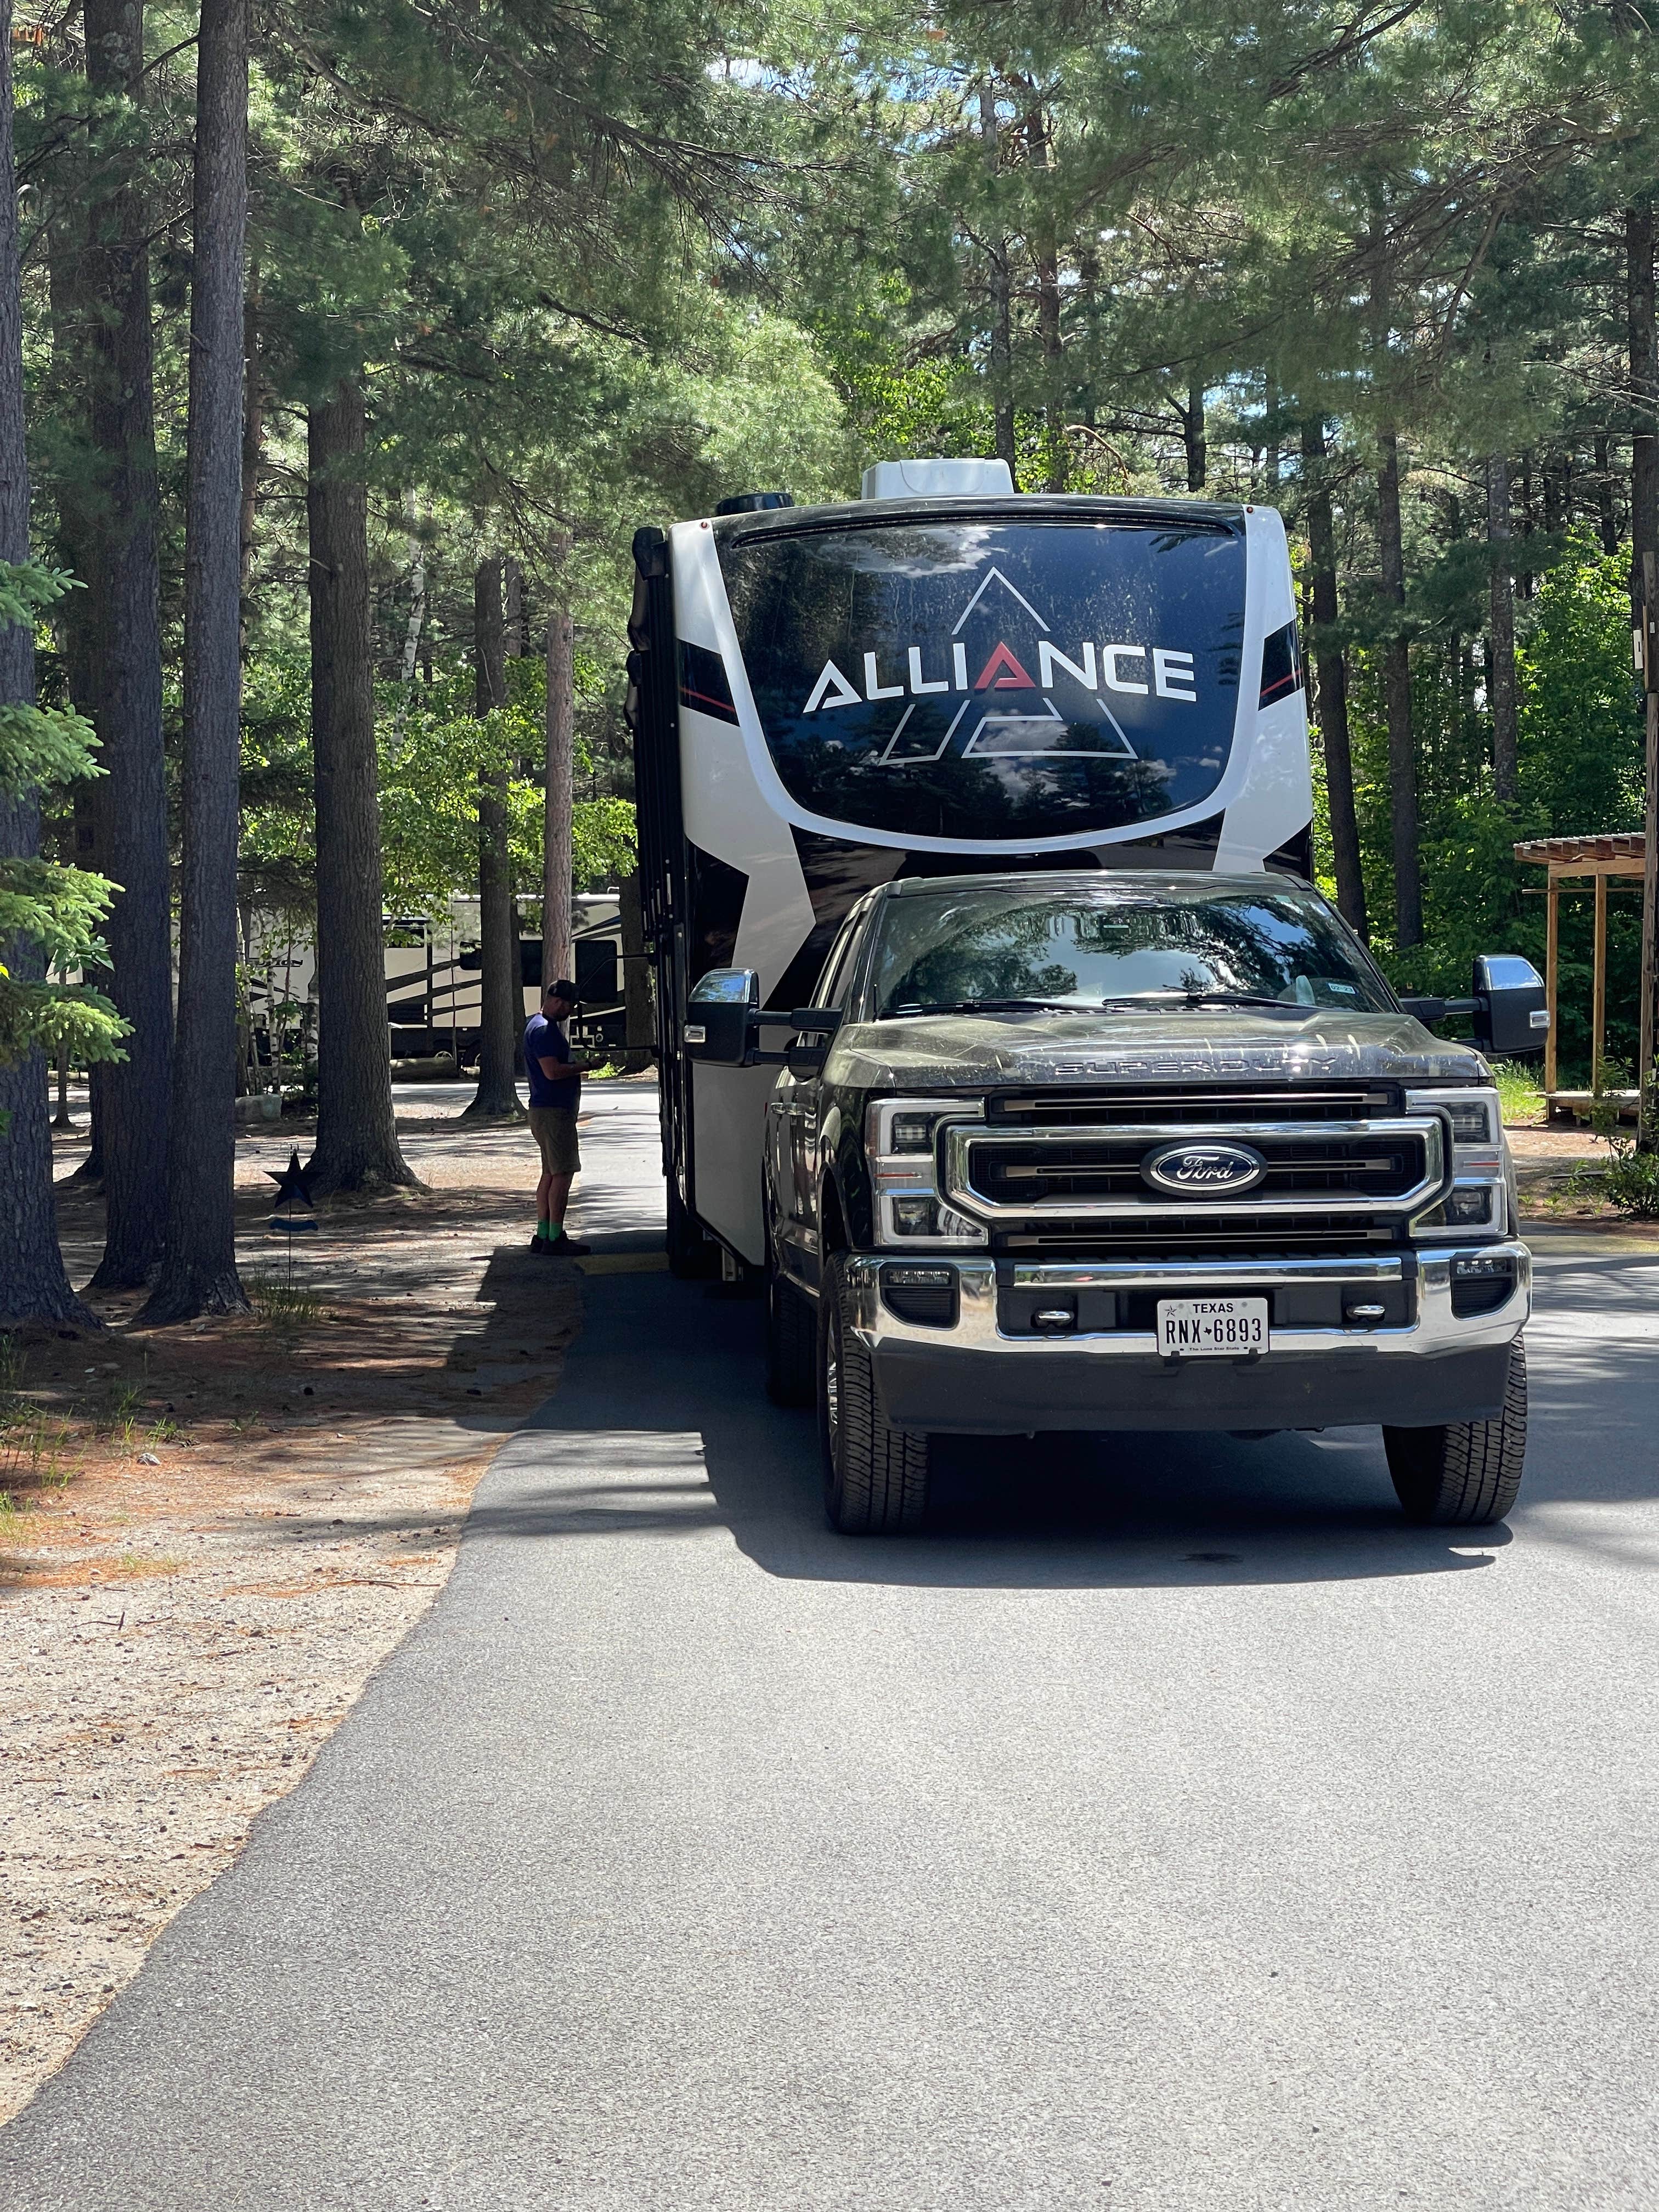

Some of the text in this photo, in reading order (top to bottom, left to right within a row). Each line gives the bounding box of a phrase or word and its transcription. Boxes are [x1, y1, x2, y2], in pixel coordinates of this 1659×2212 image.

[803, 640, 1197, 713] ALLIANCE
[1055, 1057, 1338, 1075] SUPER DUTY
[1176, 1155, 1234, 1180] Ford
[1193, 1303, 1234, 1313] TEXAS
